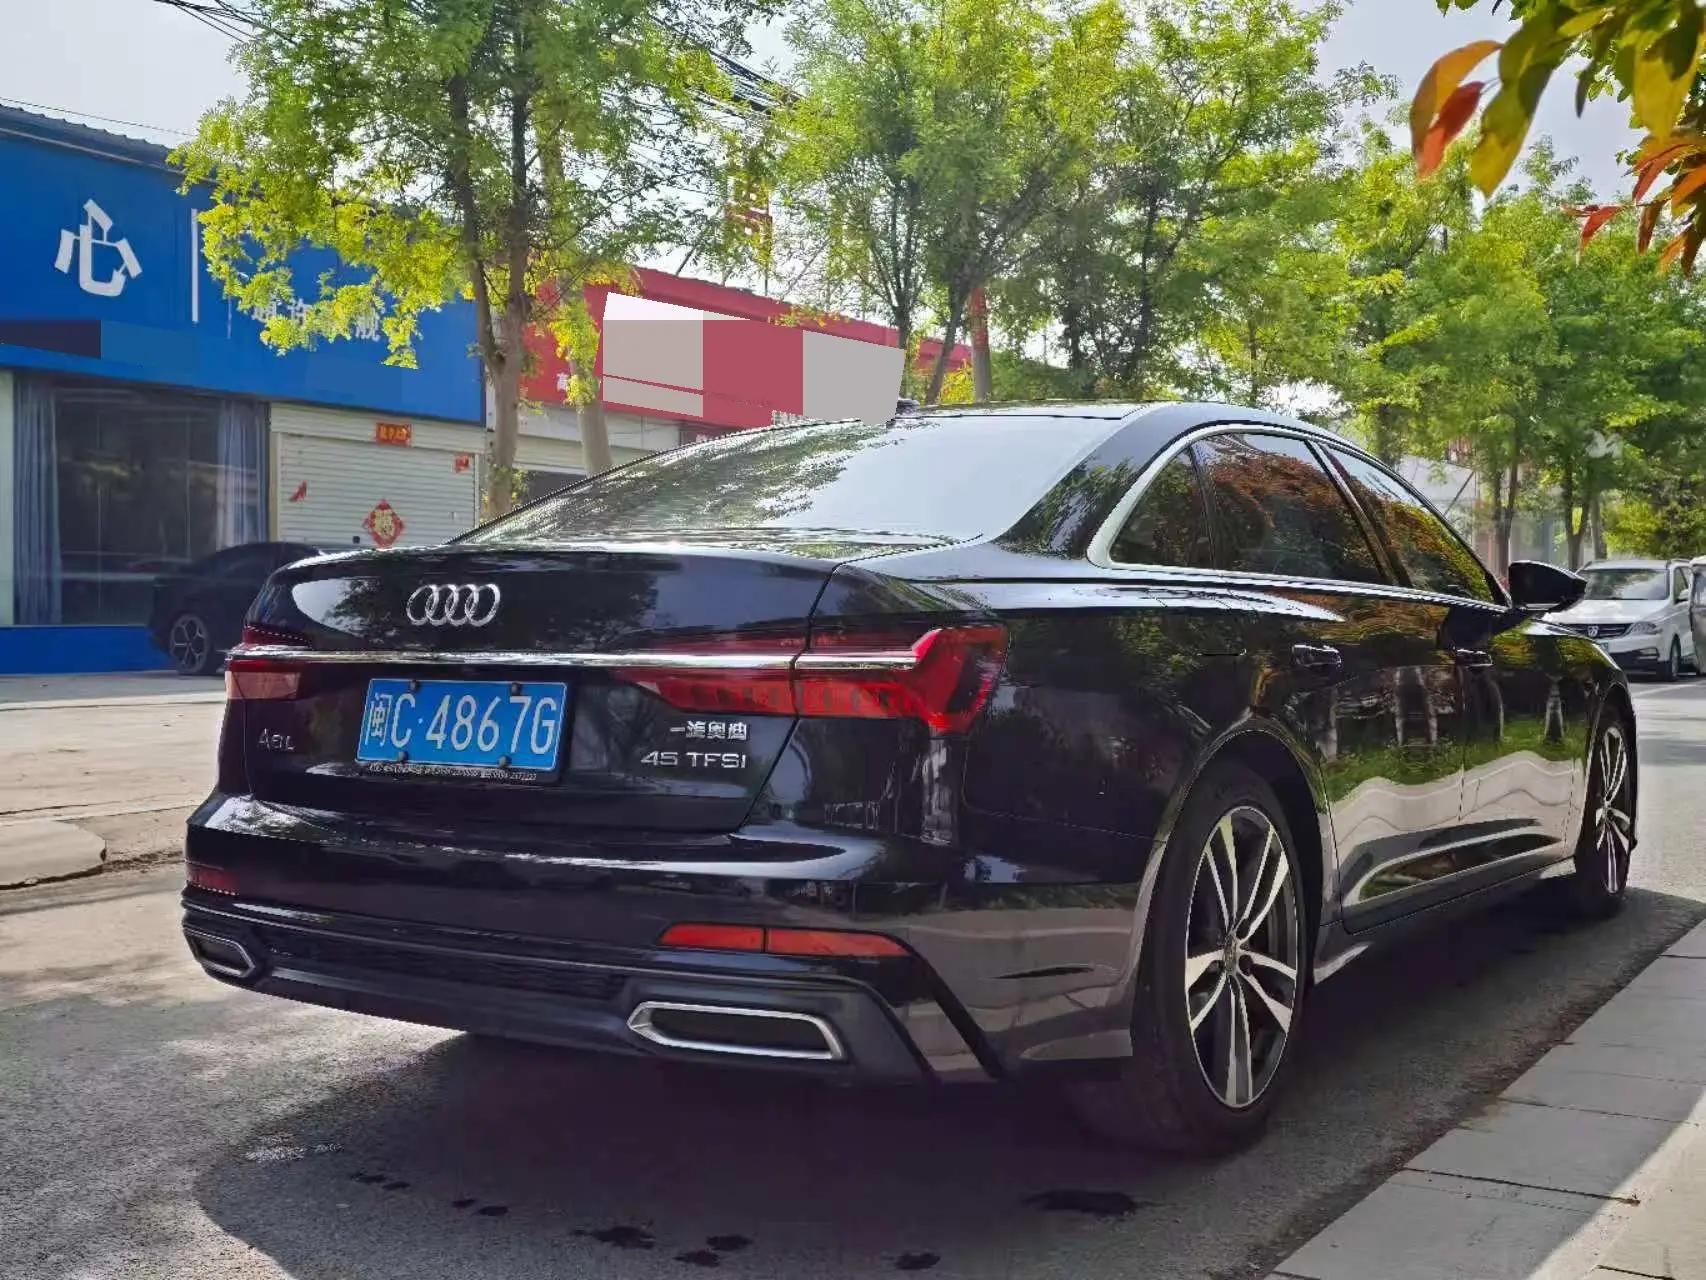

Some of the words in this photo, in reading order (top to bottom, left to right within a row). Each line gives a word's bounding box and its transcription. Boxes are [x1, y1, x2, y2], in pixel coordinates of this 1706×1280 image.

[669, 720, 747, 740] 一汽奥迪
[640, 750, 678, 766] 45
[685, 751, 747, 768] TFSI
